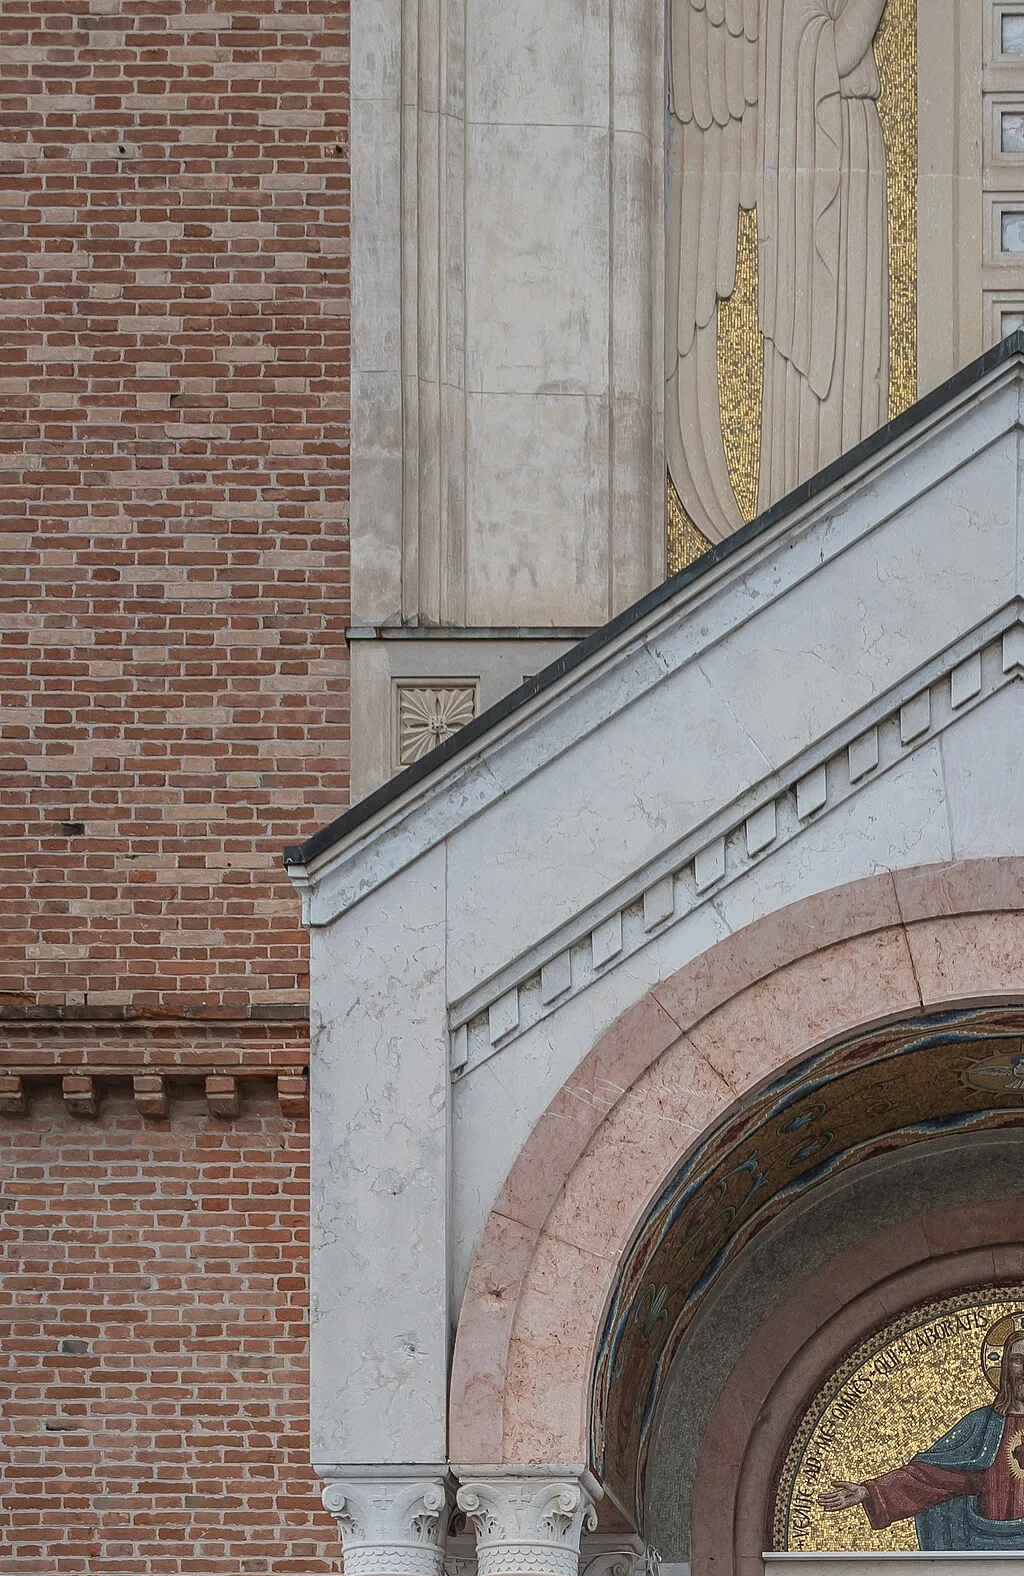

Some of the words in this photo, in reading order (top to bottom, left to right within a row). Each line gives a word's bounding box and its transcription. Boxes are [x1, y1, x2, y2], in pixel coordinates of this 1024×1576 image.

[803, 1457, 822, 1481] AD
[814, 1425, 836, 1452] ME
[831, 1374, 873, 1420] OMNES
[873, 1348, 900, 1380] QUI
[902, 1309, 989, 1355] LABORATIS
